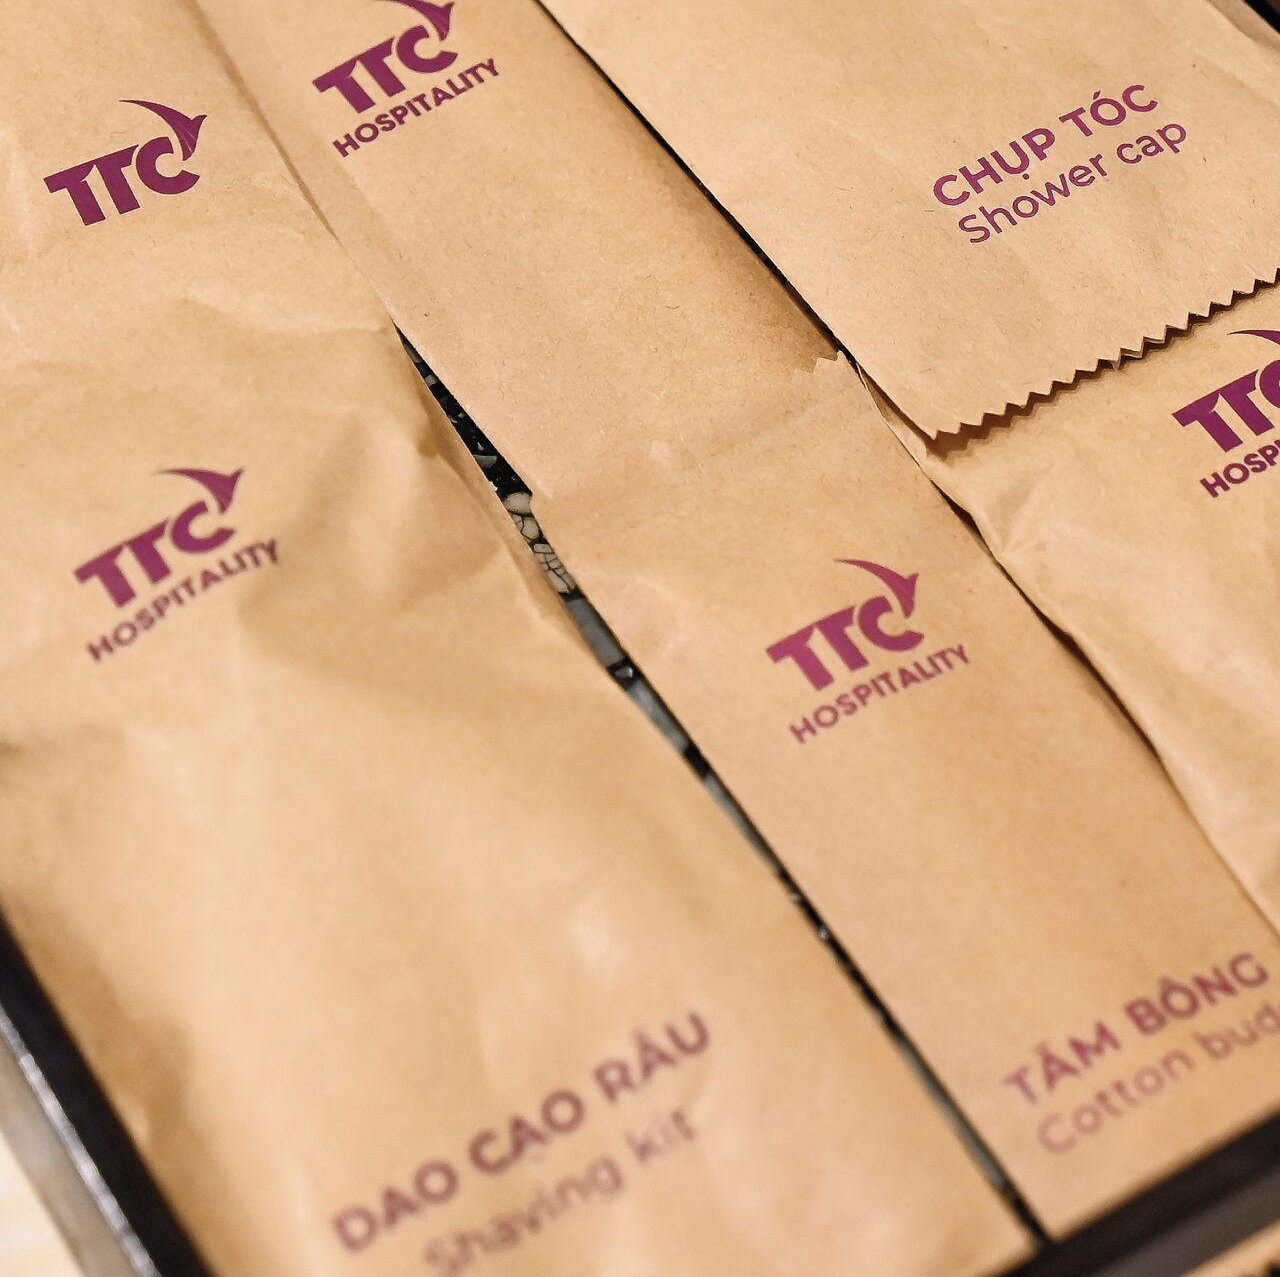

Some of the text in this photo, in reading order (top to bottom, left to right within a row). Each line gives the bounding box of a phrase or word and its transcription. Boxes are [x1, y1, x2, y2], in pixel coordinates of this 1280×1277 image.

[312, 24, 459, 114] TTC
[332, 57, 501, 158] HOSPITALITY
[43, 135, 202, 227] TTC
[933, 83, 1160, 208] CHỤP TÓC
[958, 121, 1189, 245] Shower cap
[73, 499, 236, 609] TTC
[85, 537, 280, 665] HOSPITALITY
[765, 588, 925, 692] TTC
[788, 642, 972, 745] HOSPITALITY
[1124, 950, 1270, 1037] BÔNG
[1037, 1048, 1195, 1155] Cotton
[331, 1159, 460, 1254] DAO
[468, 1089, 587, 1176] CAO
[422, 1155, 625, 1277] Shaving
